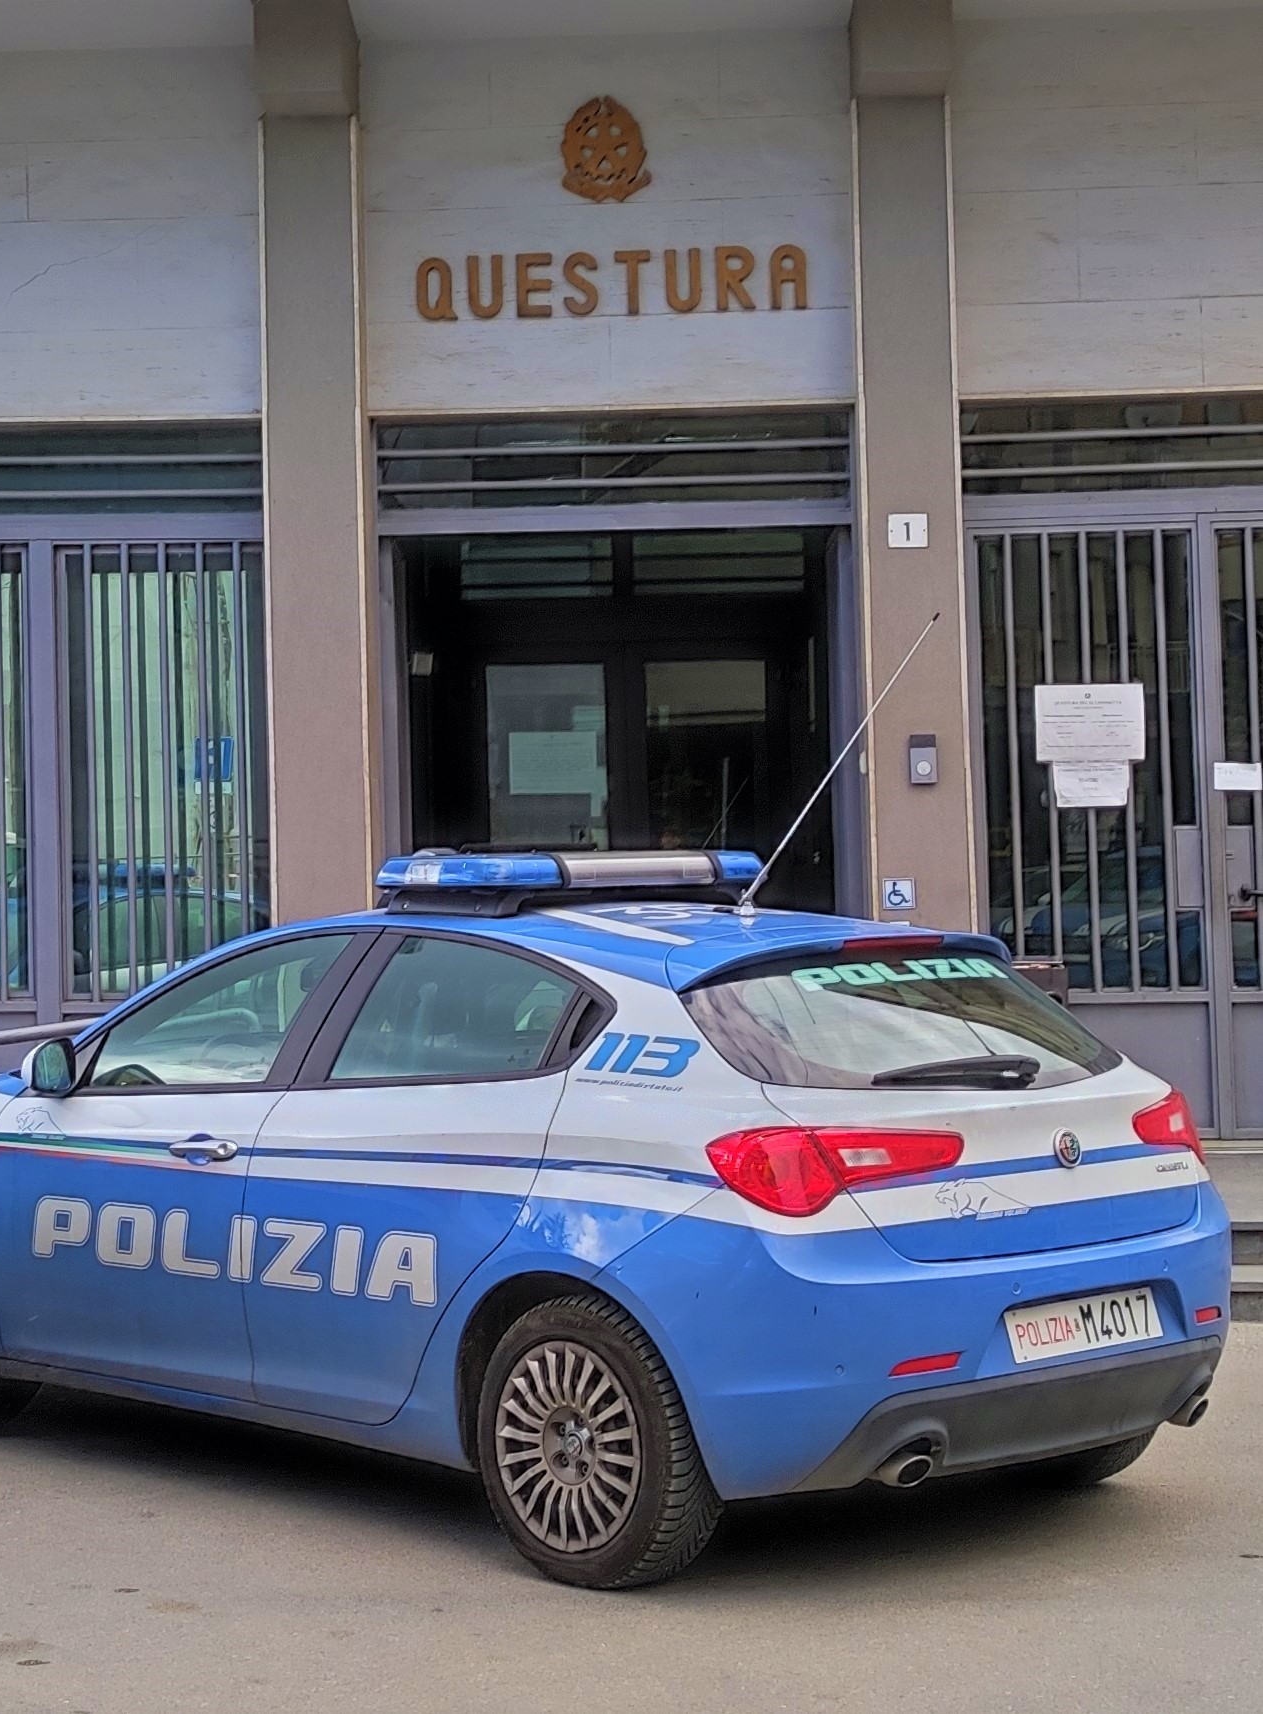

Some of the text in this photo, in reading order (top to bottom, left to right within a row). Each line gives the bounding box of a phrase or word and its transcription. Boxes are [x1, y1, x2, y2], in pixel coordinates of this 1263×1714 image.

[415, 243, 808, 321] QUESTURA
[903, 521, 911, 542] 1
[791, 958, 1009, 993] POLIZIA
[584, 1032, 701, 1078] 113
[32, 1195, 438, 1307] POLIZIA
[1015, 1294, 1148, 1349] POLIZIA M4017
